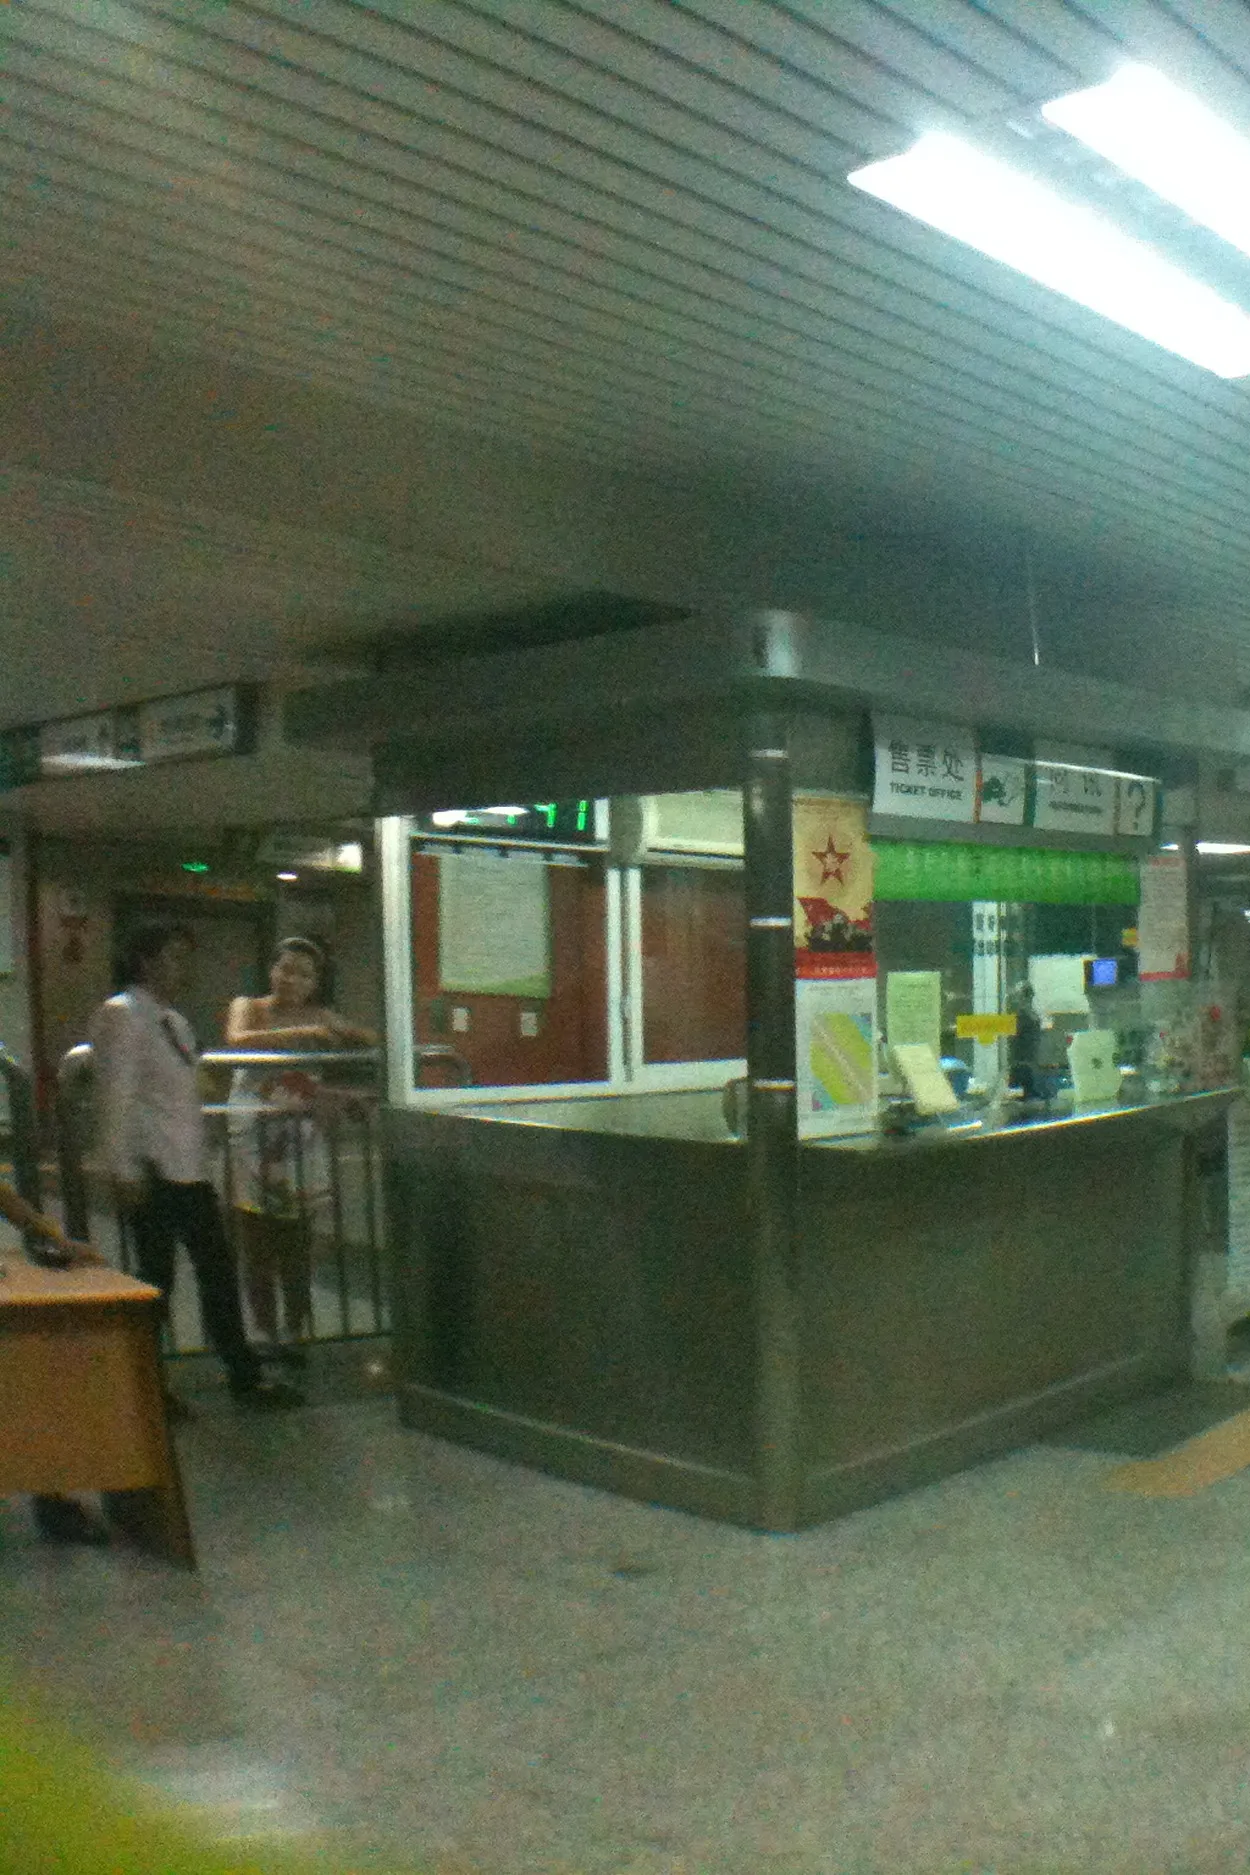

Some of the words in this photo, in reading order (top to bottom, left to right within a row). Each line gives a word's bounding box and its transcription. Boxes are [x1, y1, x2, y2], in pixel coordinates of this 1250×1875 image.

[888, 739, 965, 782] 售票处
[889, 782, 926, 796] TICKET
[928, 787, 963, 801] OFFICE
